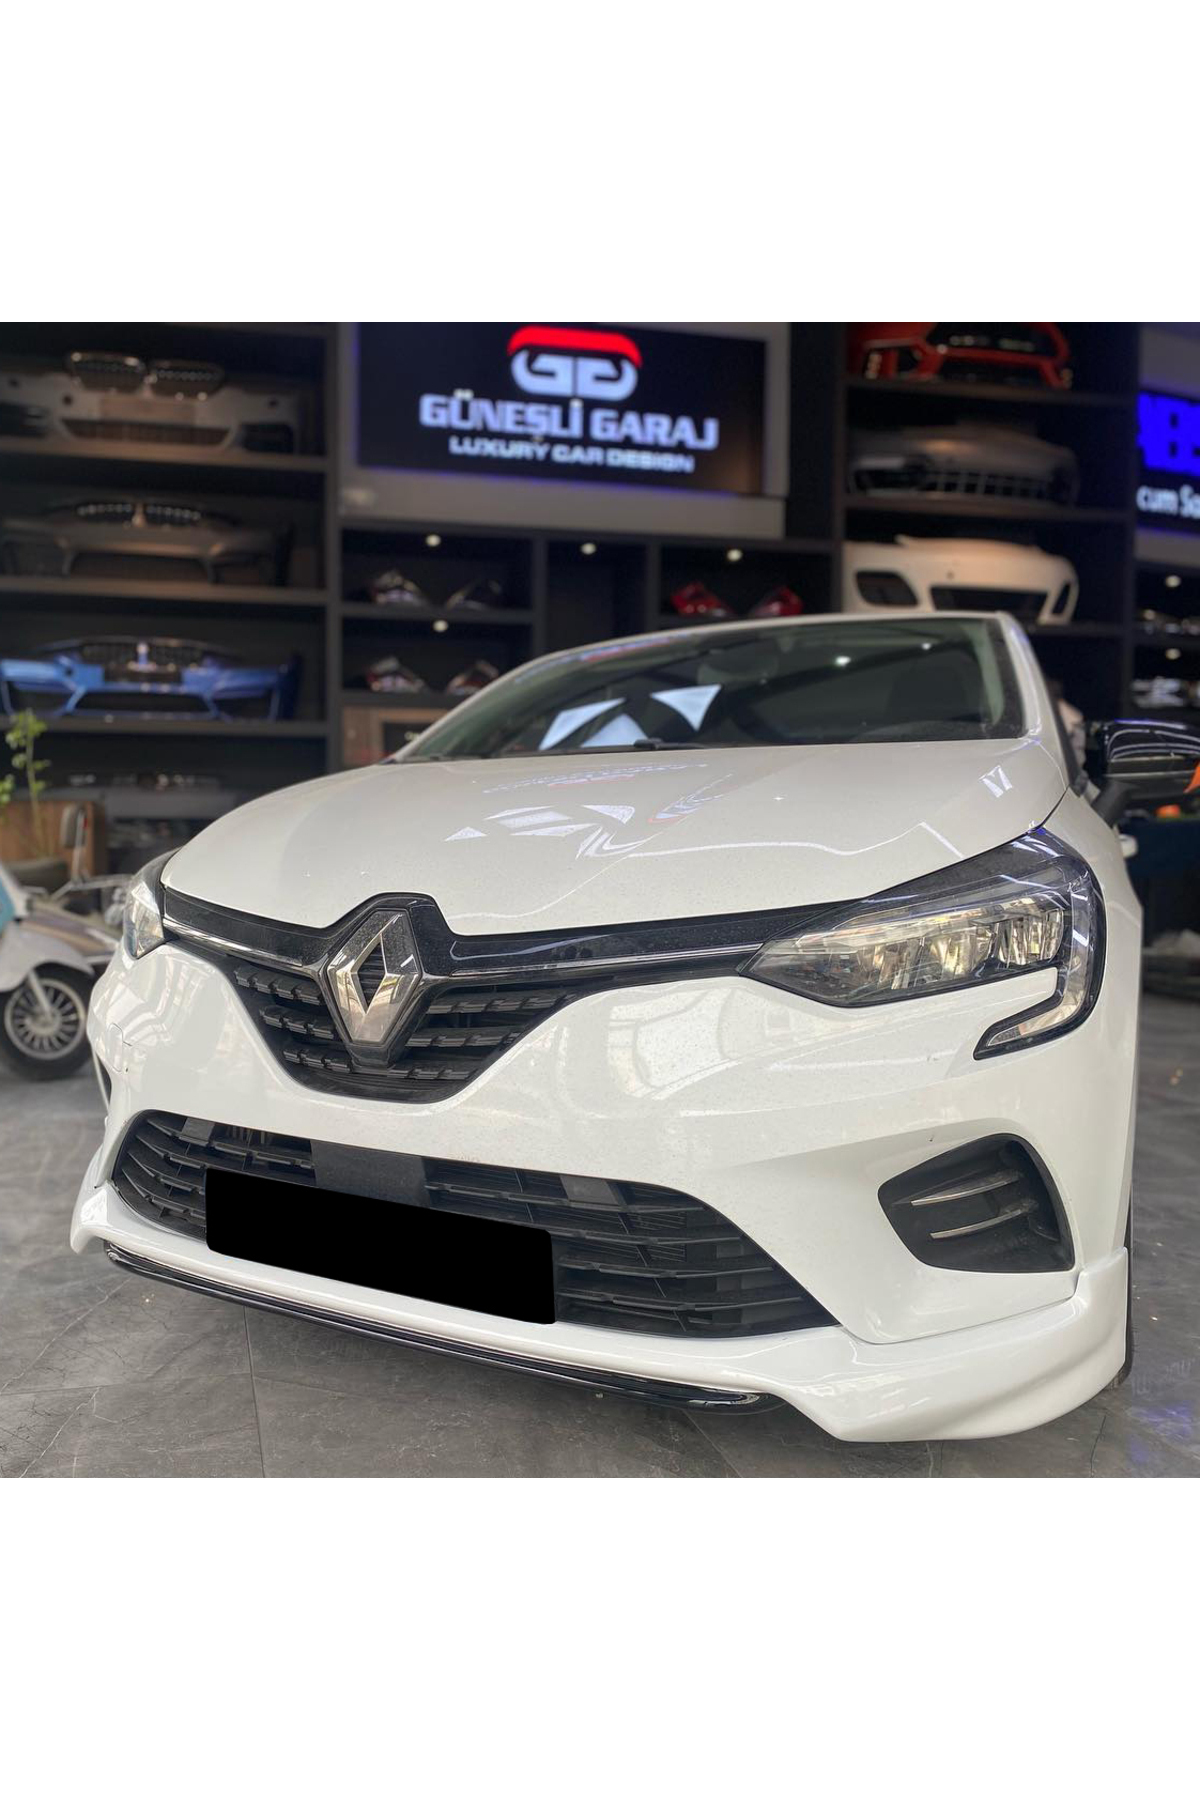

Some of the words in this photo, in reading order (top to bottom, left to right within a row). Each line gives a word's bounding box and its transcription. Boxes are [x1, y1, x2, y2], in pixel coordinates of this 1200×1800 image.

[419, 389, 583, 441] GÜNEŞLİ
[589, 408, 719, 450] GARAJ
[449, 435, 549, 461] LUXURY
[551, 444, 603, 466] CAR
[606, 450, 695, 473] DESIGN
